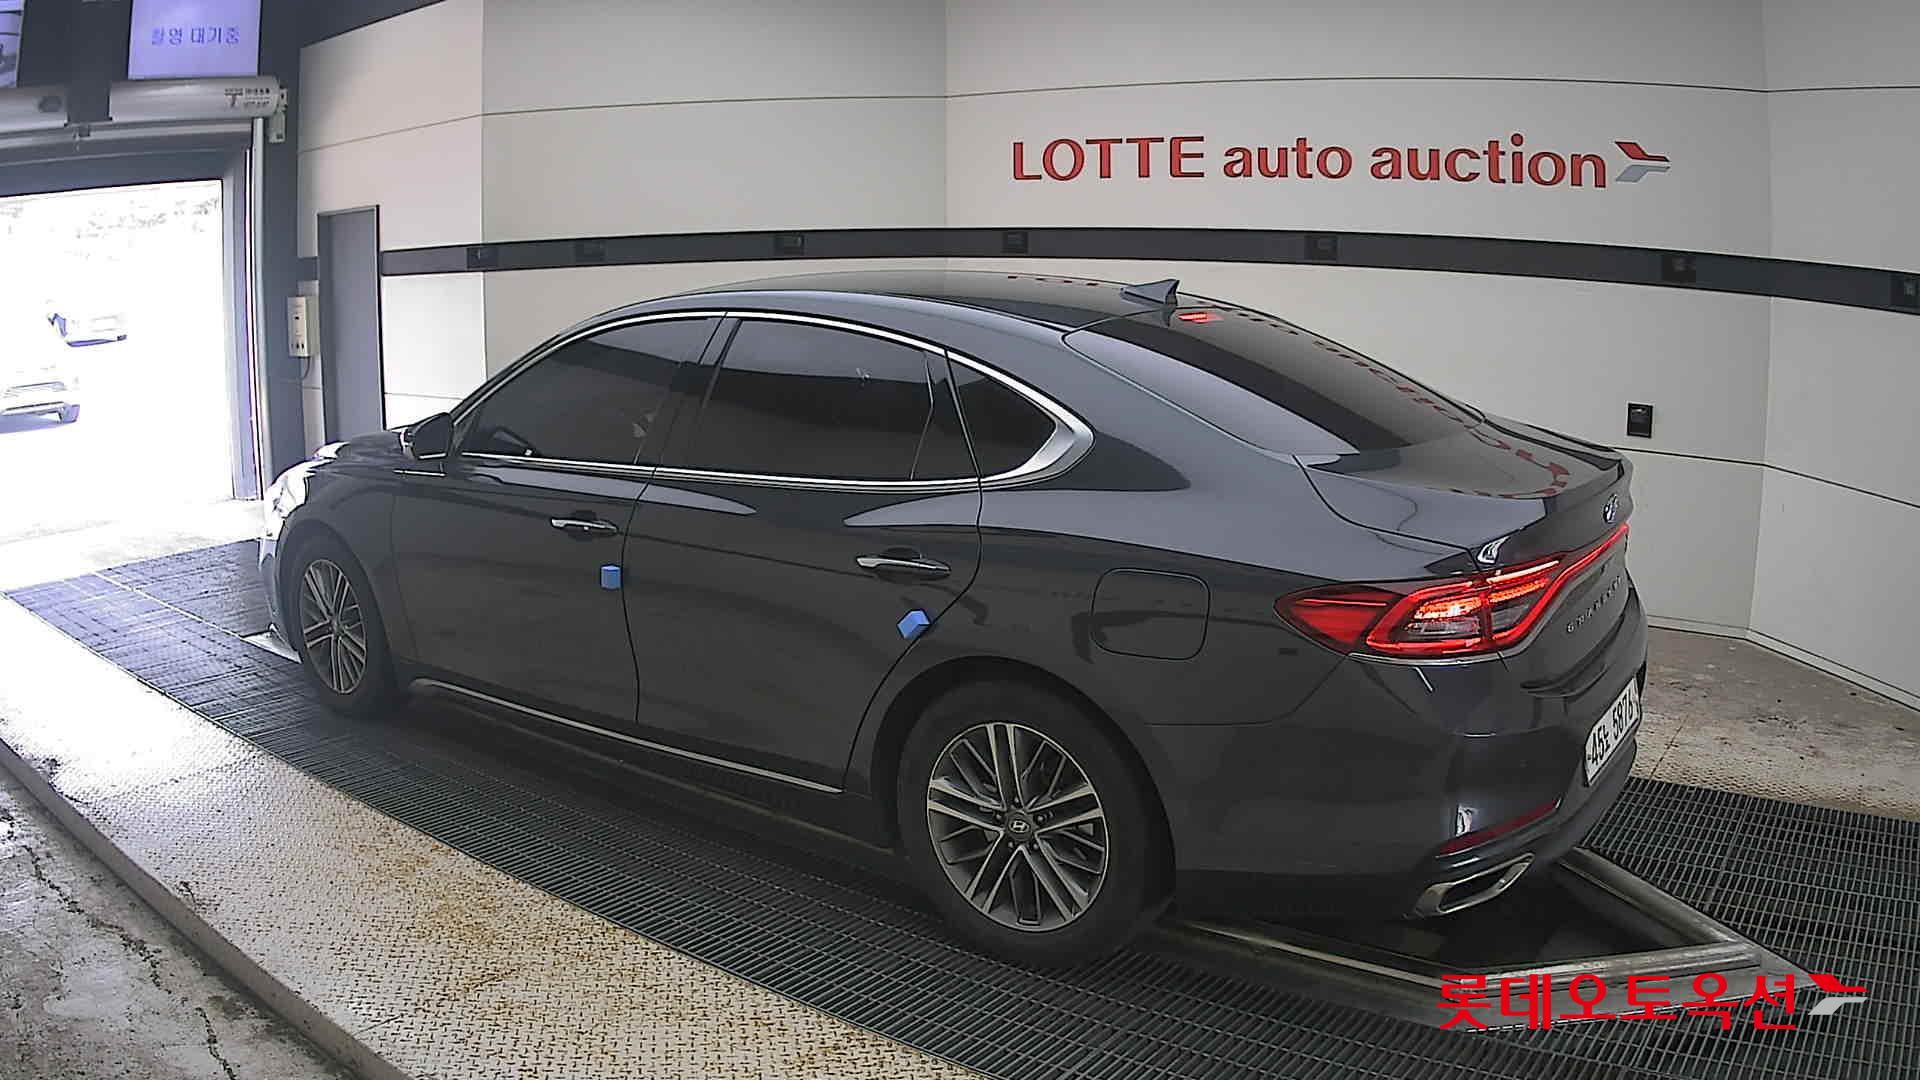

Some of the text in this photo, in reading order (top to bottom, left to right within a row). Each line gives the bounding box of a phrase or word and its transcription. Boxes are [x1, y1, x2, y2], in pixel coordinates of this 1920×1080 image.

[1012, 133, 1607, 188] LOTTE auto auction
[1612, 687, 1634, 741] 5876
